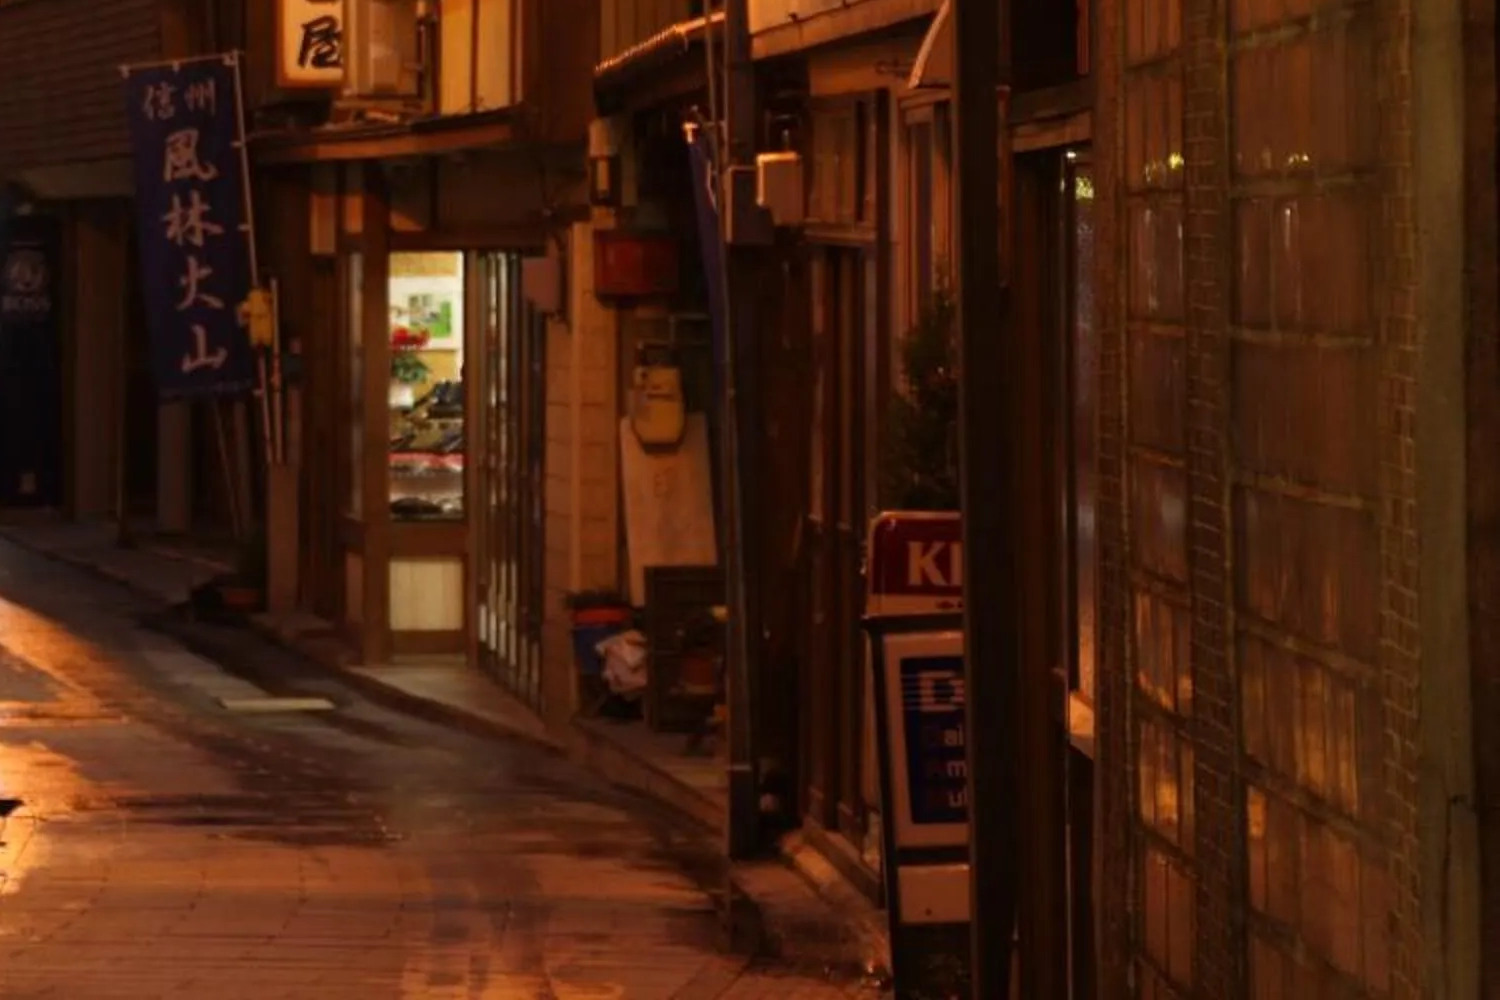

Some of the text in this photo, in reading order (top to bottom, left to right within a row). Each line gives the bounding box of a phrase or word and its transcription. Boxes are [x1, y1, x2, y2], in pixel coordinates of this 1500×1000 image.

[143, 77, 216, 121] 信州
[162, 129, 228, 373] 風林火山
